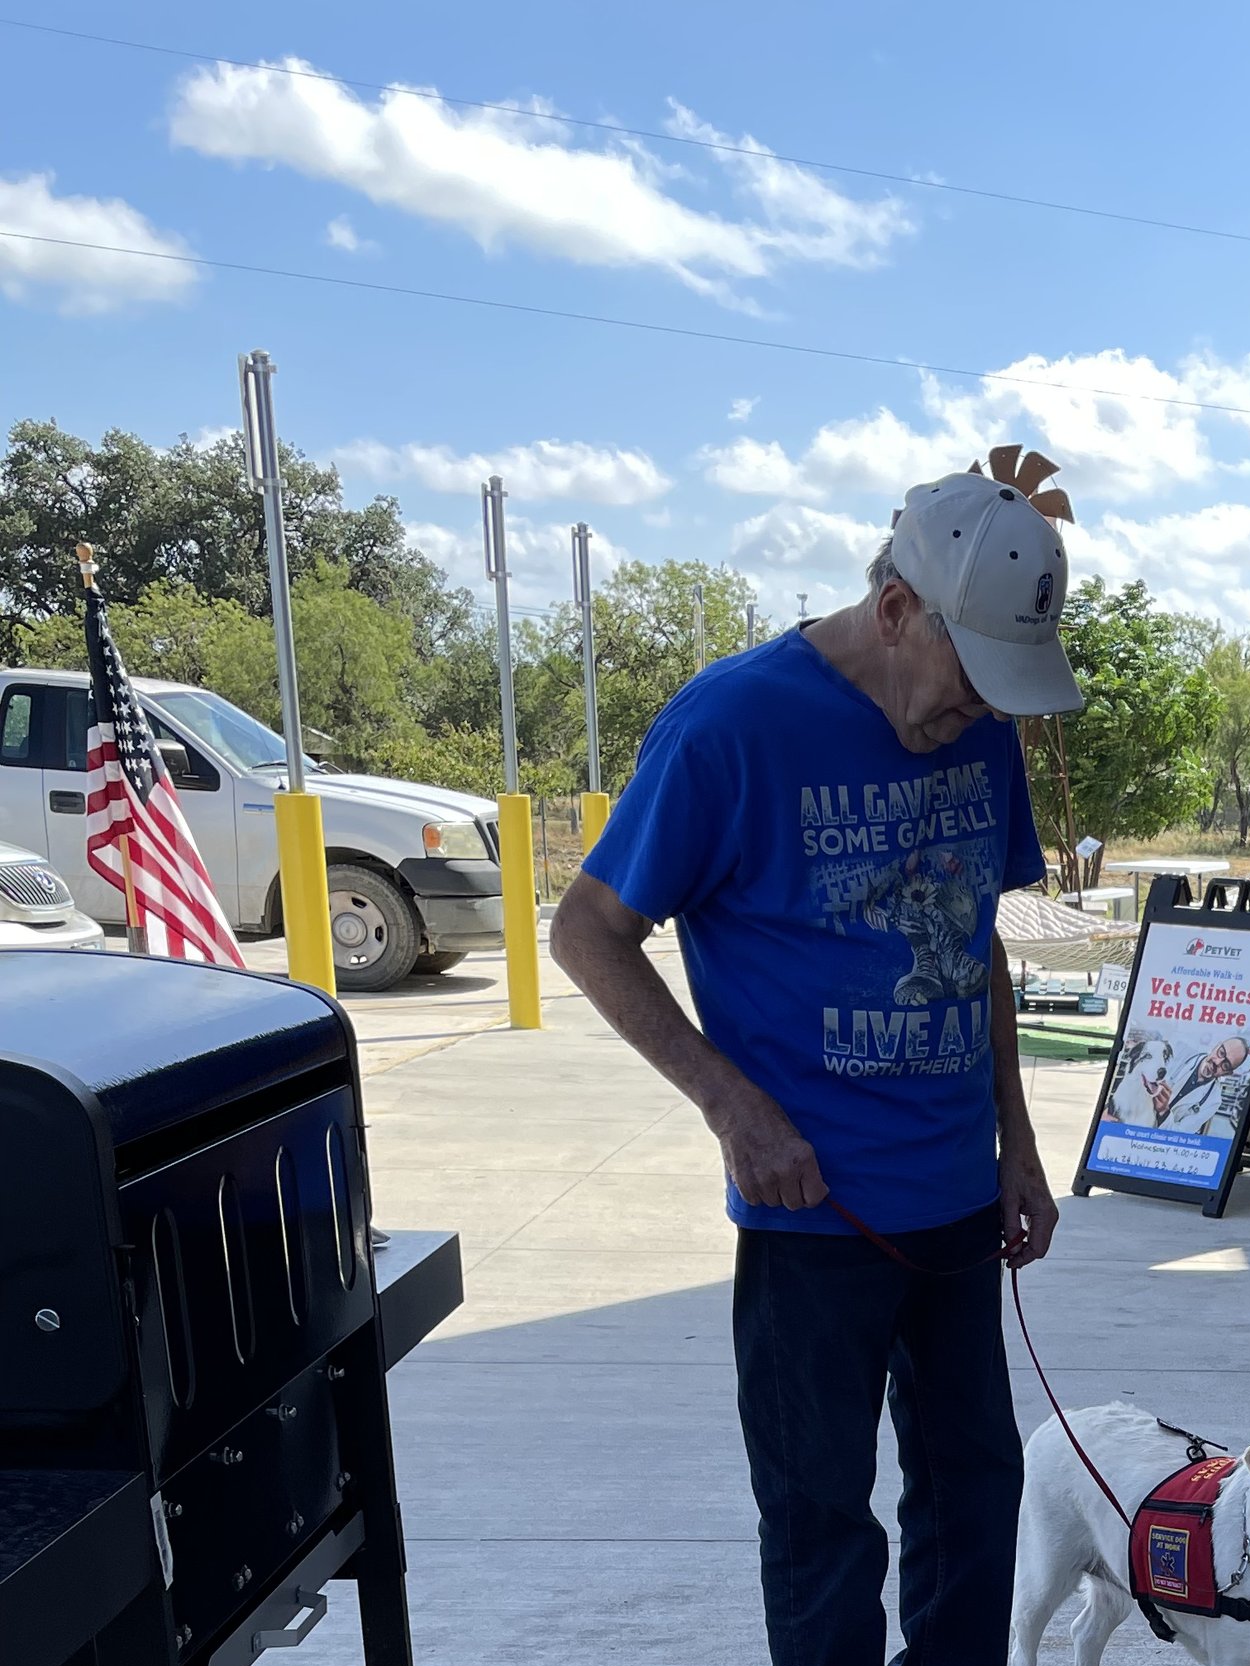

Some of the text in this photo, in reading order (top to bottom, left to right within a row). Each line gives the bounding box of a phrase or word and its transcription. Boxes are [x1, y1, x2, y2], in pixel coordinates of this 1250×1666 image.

[801, 785, 858, 827] ALL
[803, 801, 997, 857] SOME GAVE ALL
[1171, 966, 1243, 980] Affordable Walk-in
[1151, 977, 1181, 997] Vet
[1147, 1000, 1247, 1027] Held Here
[823, 1007, 931, 1059] LIVE
[938, 1006, 965, 1056] A
[823, 1054, 902, 1078] WORTH
[909, 1057, 961, 1075] THEIR
[1152, 1533, 1174, 1541] SERVICE
